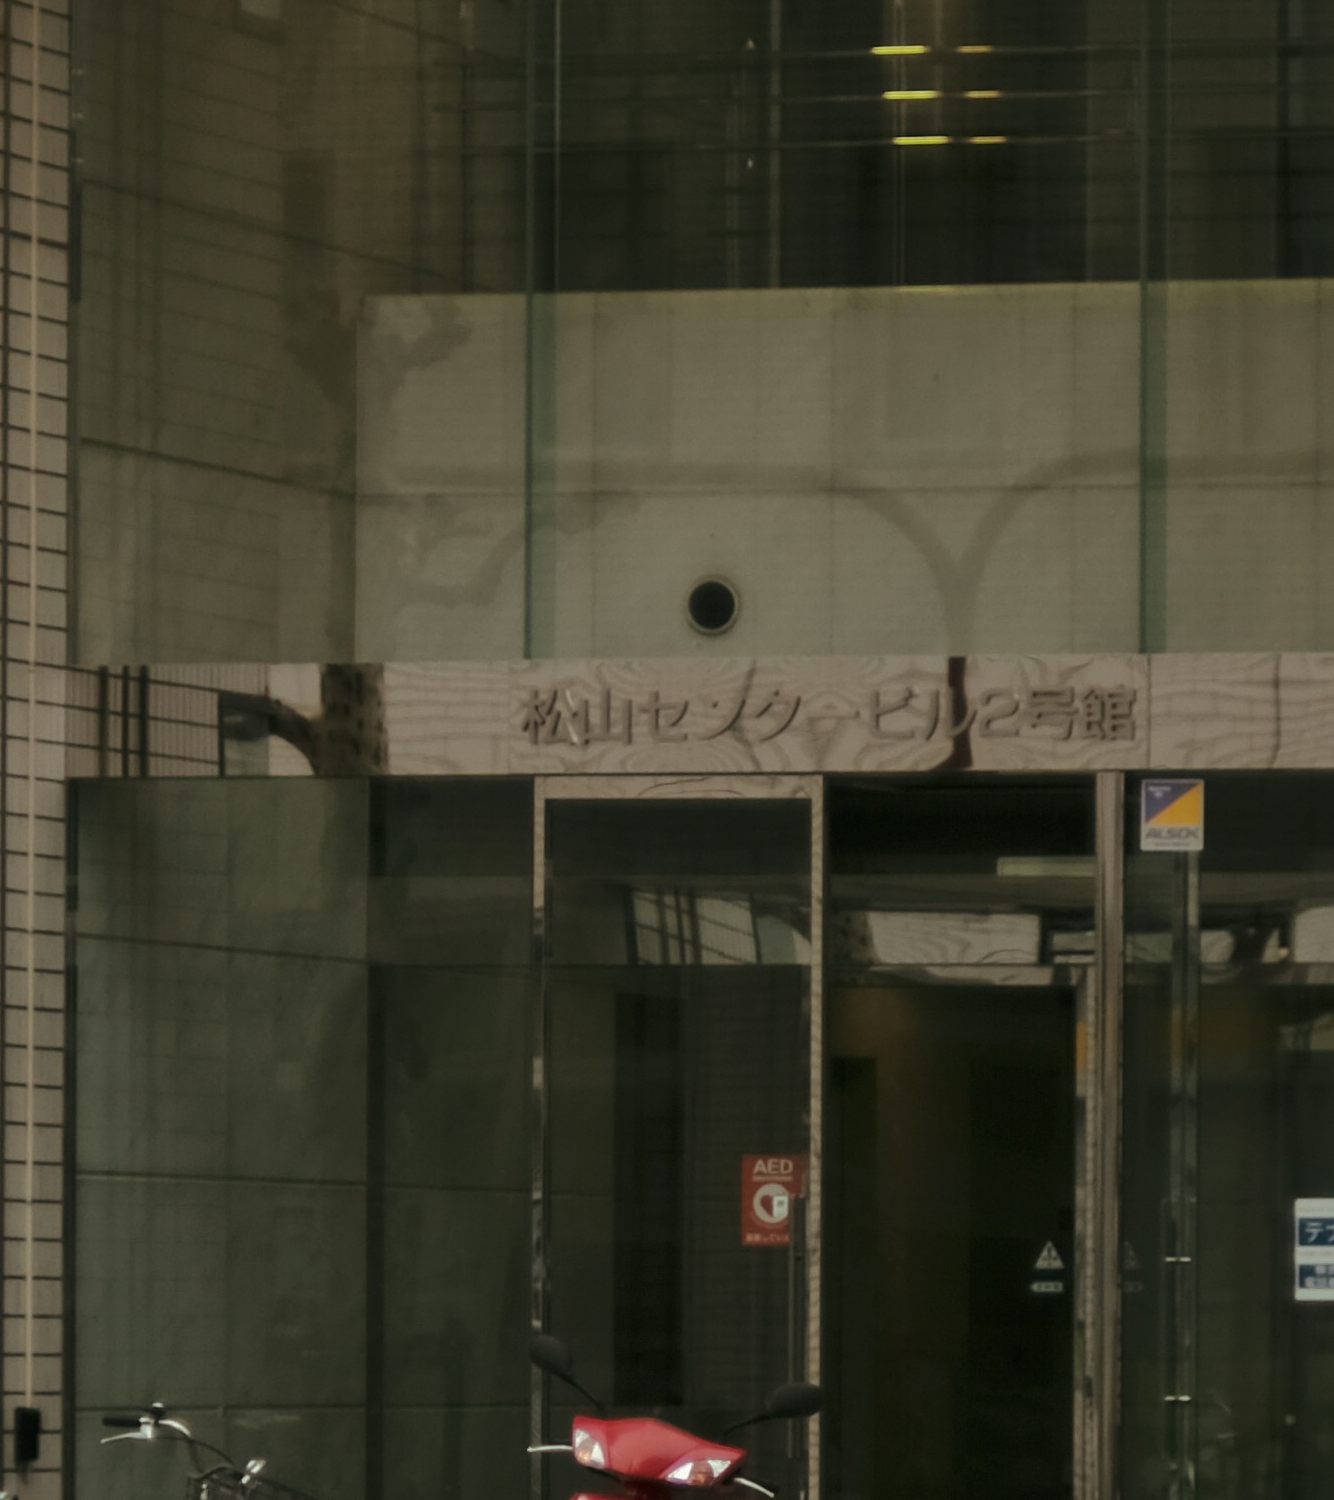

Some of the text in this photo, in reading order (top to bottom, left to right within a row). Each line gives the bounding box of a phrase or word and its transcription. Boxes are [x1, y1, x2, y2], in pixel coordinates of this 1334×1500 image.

[522, 686, 1138, 746] 松山センタービル2号館
[753, 1158, 794, 1174] AED
